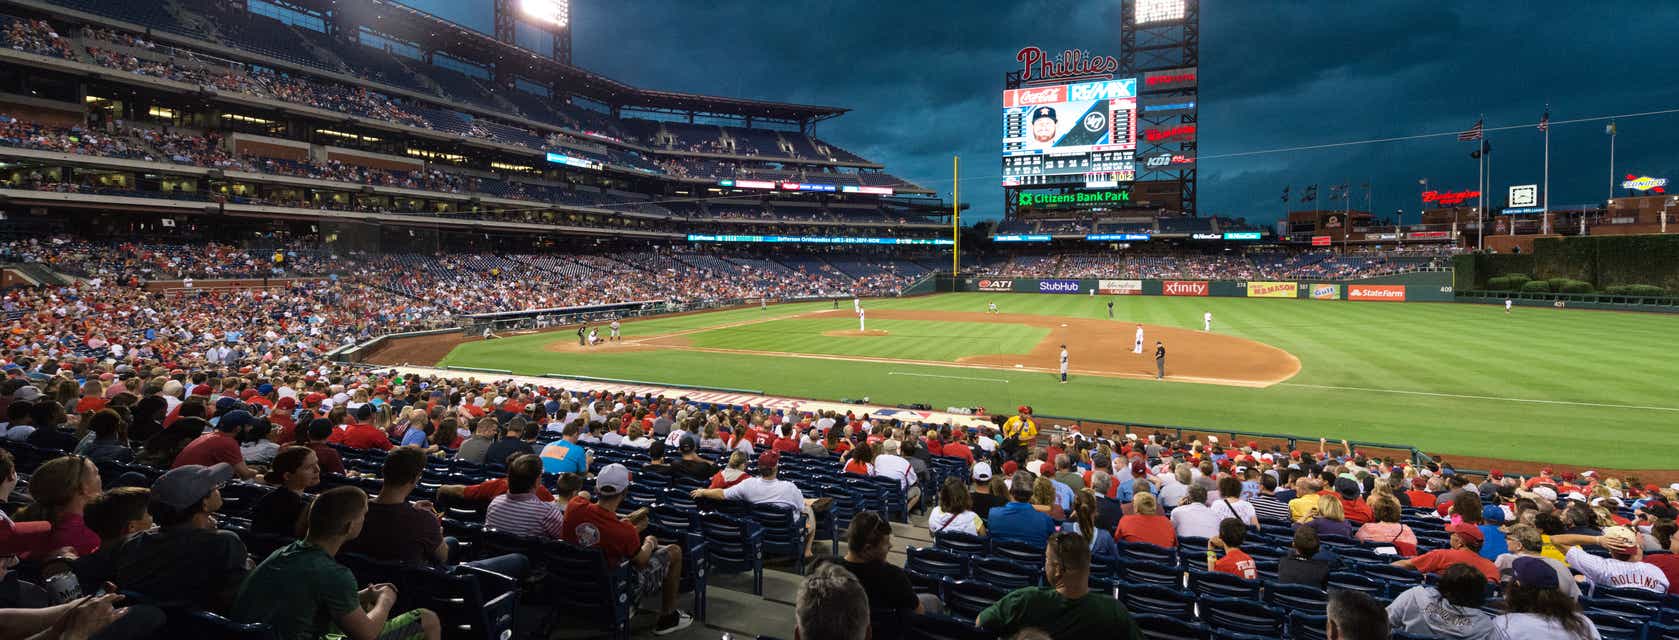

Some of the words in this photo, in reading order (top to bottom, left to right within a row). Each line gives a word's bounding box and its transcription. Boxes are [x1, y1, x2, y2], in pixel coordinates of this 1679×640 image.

[1016, 46, 1118, 79] Phillies
[1035, 193, 1075, 203] Citizens
[1077, 192, 1104, 202] Bank
[1105, 191, 1129, 201] Park
[990, 280, 1012, 288] ATI
[1040, 282, 1078, 291] StubHub
[1166, 282, 1205, 294] xfinity
[1314, 287, 1334, 296] Gulf
[1610, 573, 1659, 589] ROLLINS
